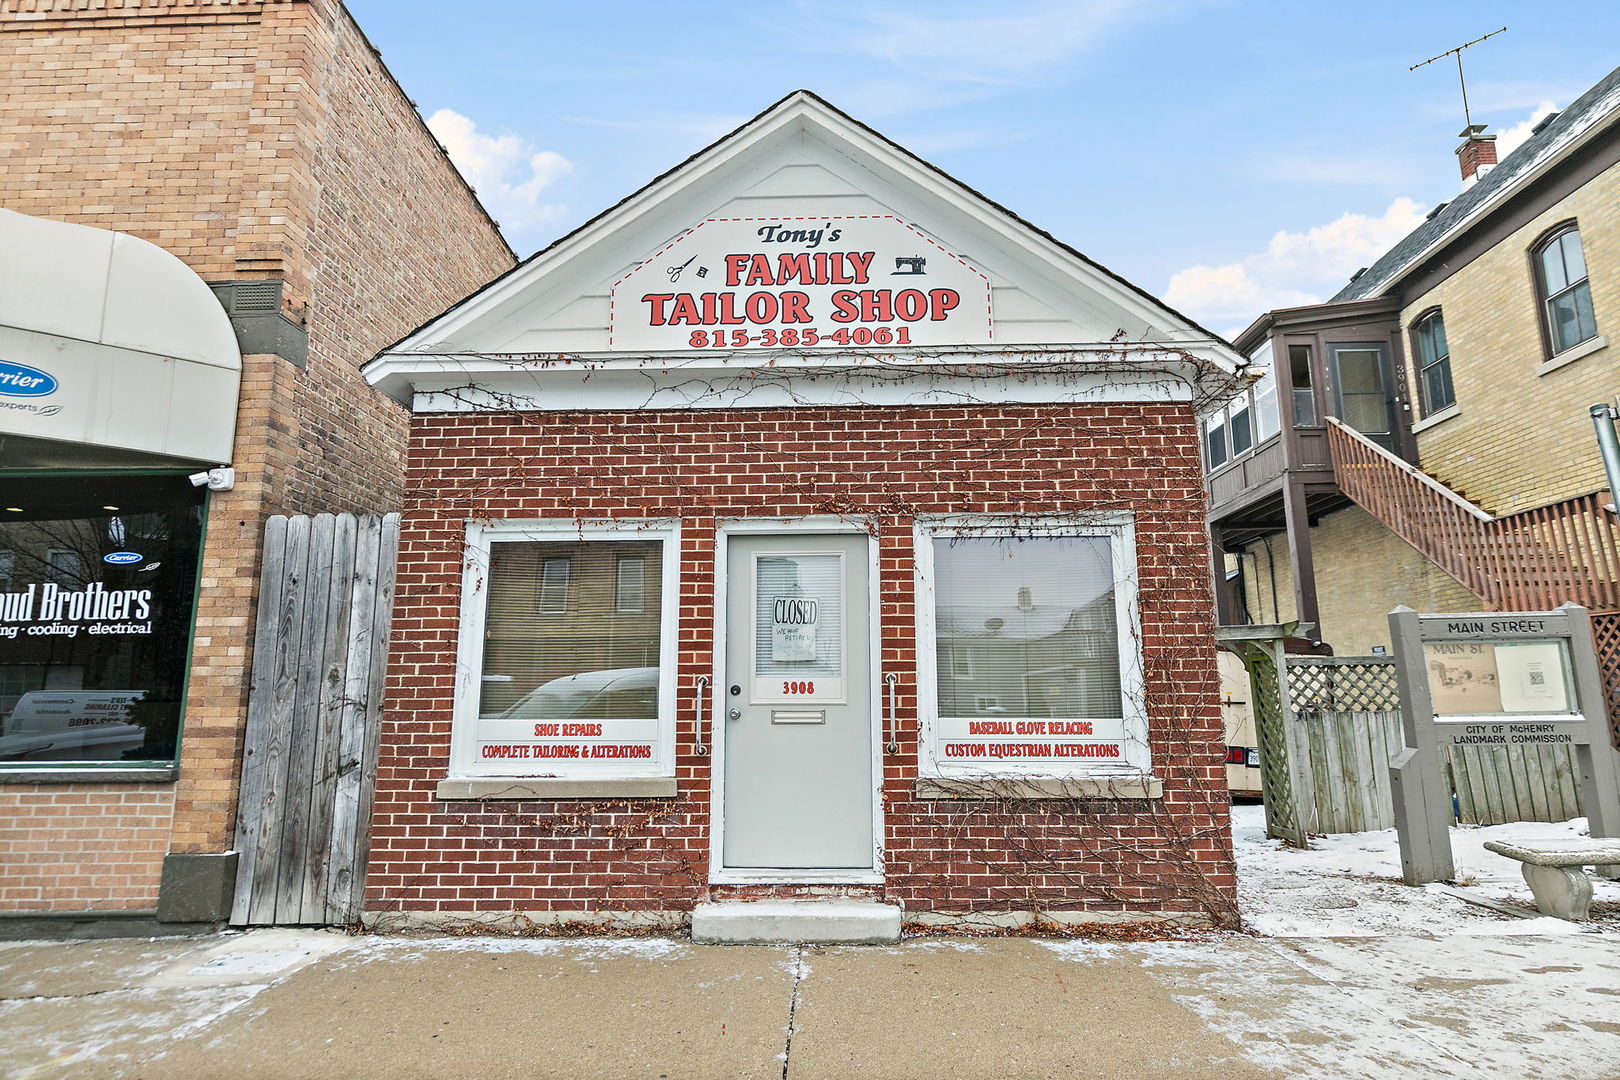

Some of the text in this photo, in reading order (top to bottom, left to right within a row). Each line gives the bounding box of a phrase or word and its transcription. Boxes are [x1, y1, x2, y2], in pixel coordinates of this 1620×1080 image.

[757, 222, 842, 248] Tony's
[724, 251, 875, 287] FAMILY
[641, 288, 961, 326] TAILOR SHOP
[688, 326, 912, 348] 815-385-4061
[0, 371, 44, 388] rier
[38, 581, 152, 621] Brothers
[774, 599, 817, 625] CLOSED
[27, 622, 79, 638] cooling
[88, 621, 152, 635] electrical
[1448, 620, 1545, 634] MAIN STREET
[1433, 644, 1464, 655] MAIN
[782, 681, 815, 695] 3908
[533, 723, 603, 737] SHOE REPAIRS
[969, 721, 1093, 735] BASEBALL GLOVE RELACING
[1465, 724, 1555, 734] CITY OF McHENRY
[1453, 734, 1572, 744] LANDMARK COMMISSION
[482, 744, 652, 759] COMPLETE TAILORING & ALTERATIONS
[945, 743, 1120, 760] CUSTOM EQUESTRIAN ALTERATIONS
